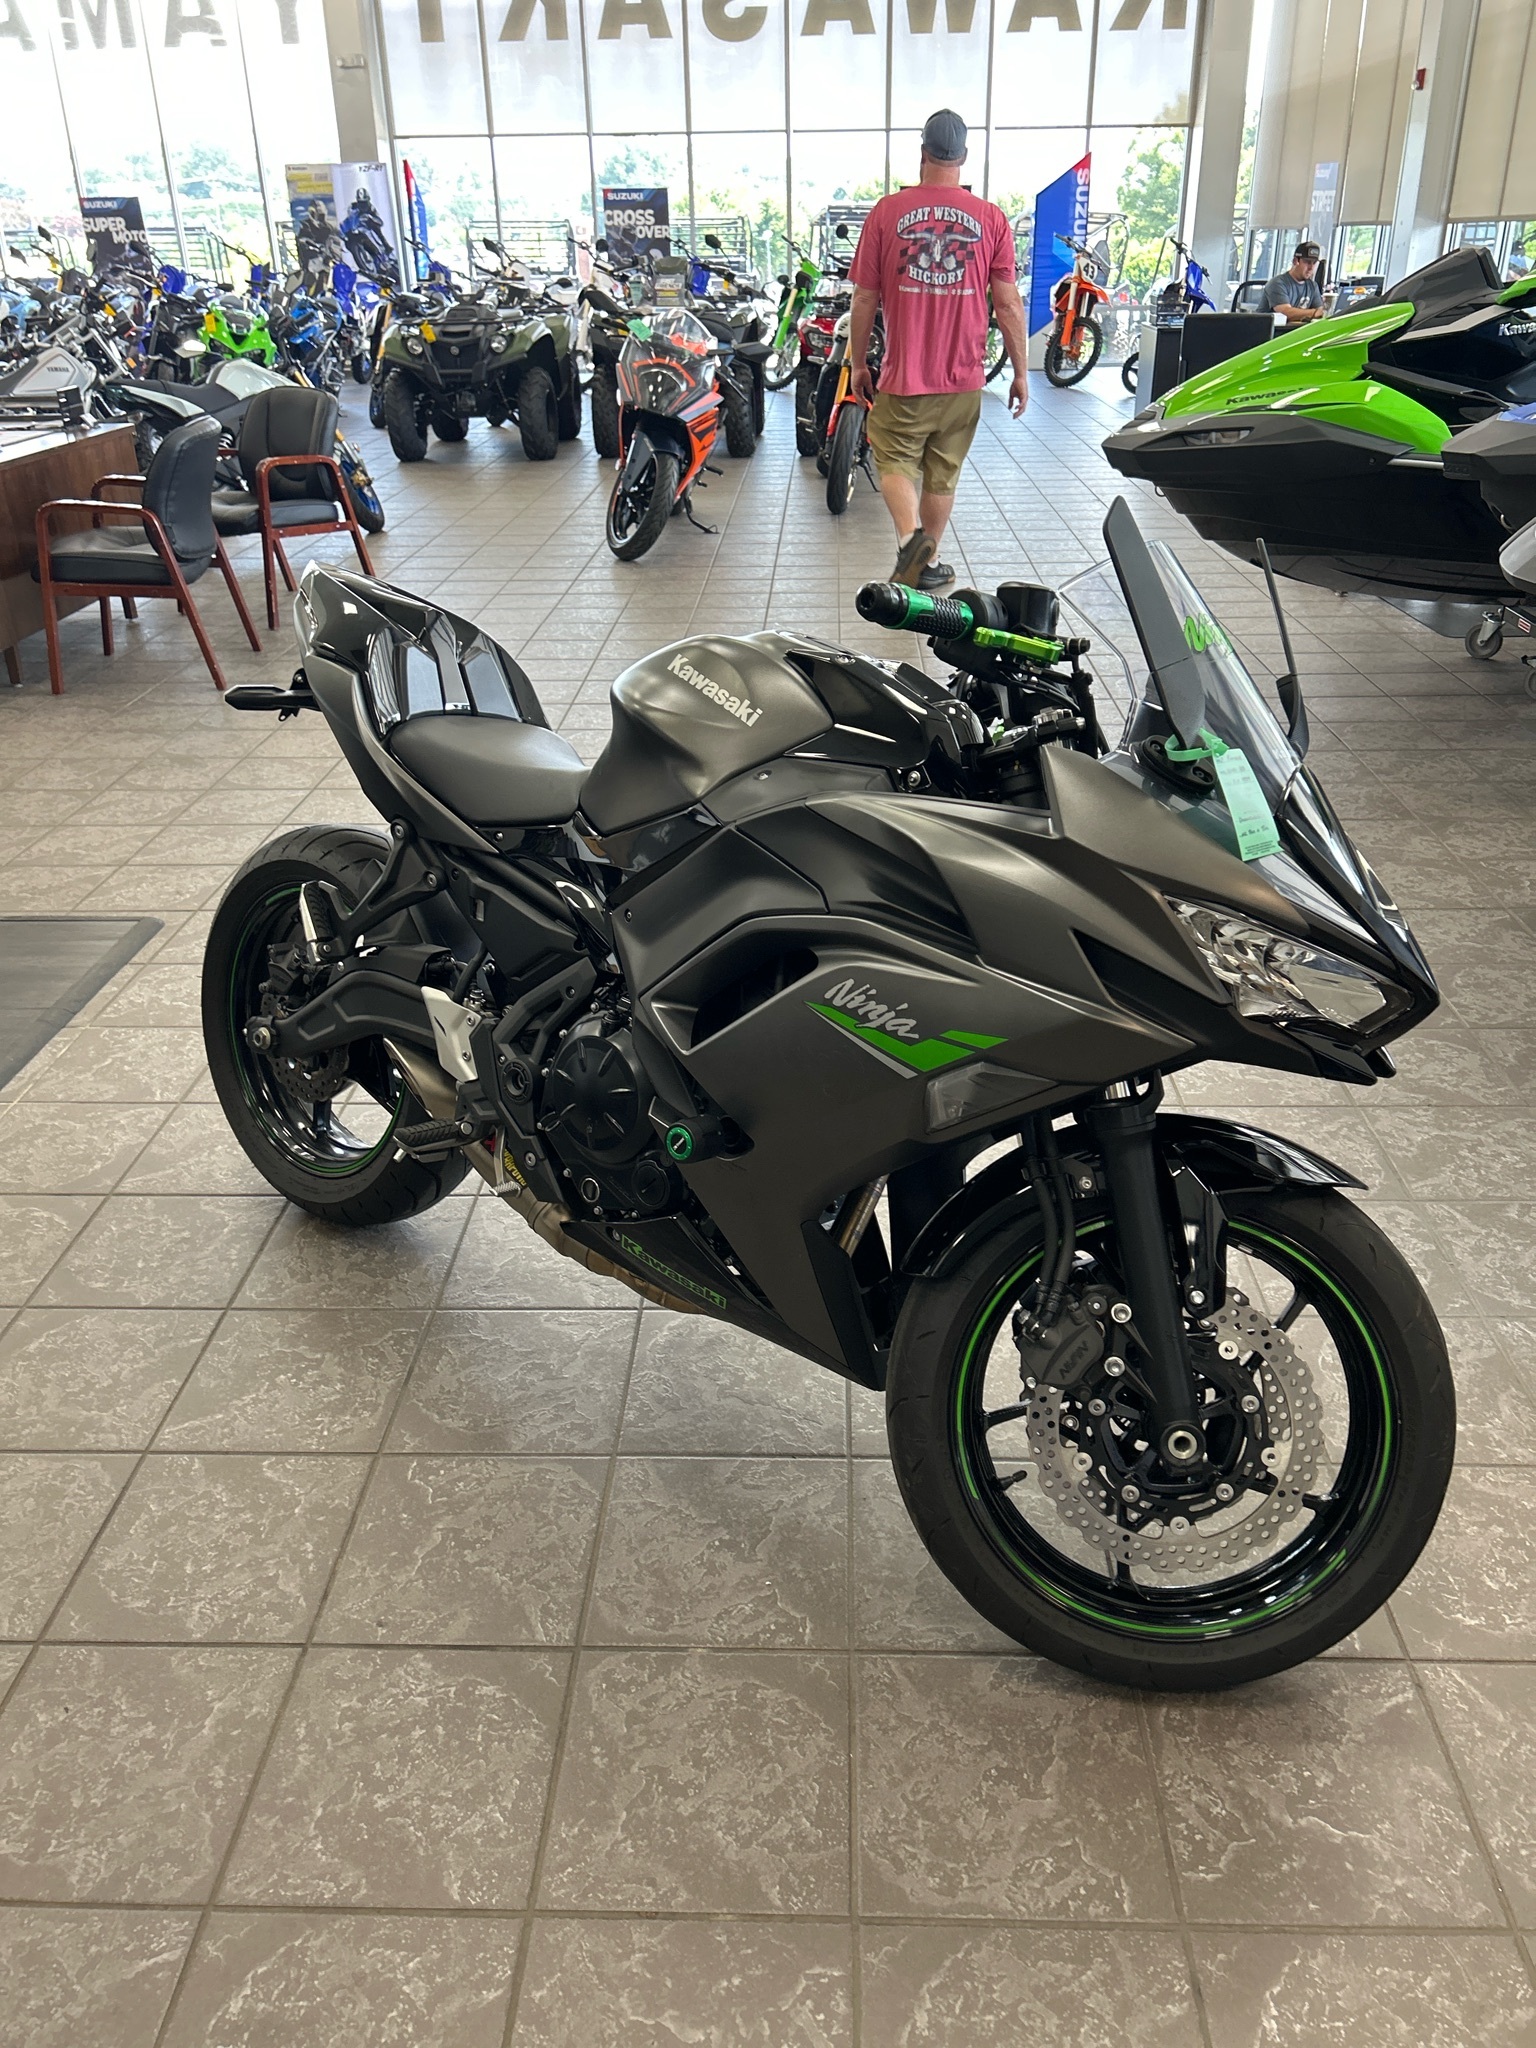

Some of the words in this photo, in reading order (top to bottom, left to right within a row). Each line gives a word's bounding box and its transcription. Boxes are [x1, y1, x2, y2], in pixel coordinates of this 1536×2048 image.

[83, 200, 118, 210] SUZUKI
[607, 192, 644, 200] SUZUKI
[604, 208, 655, 226] CROSS
[1073, 167, 1090, 250] SUZUK
[83, 216, 126, 232] SUPER
[897, 206, 931, 234] GREAT
[933, 206, 982, 238] WESTERN
[112, 229, 147, 244] MOTO
[635, 225, 670, 239] OVER
[909, 265, 965, 286] HICKORY
[1083, 262, 1095, 280] 43
[667, 653, 763, 727] Kawasaki
[824, 978, 920, 1039] Ninja
[621, 1234, 727, 1310] Kawasaki
